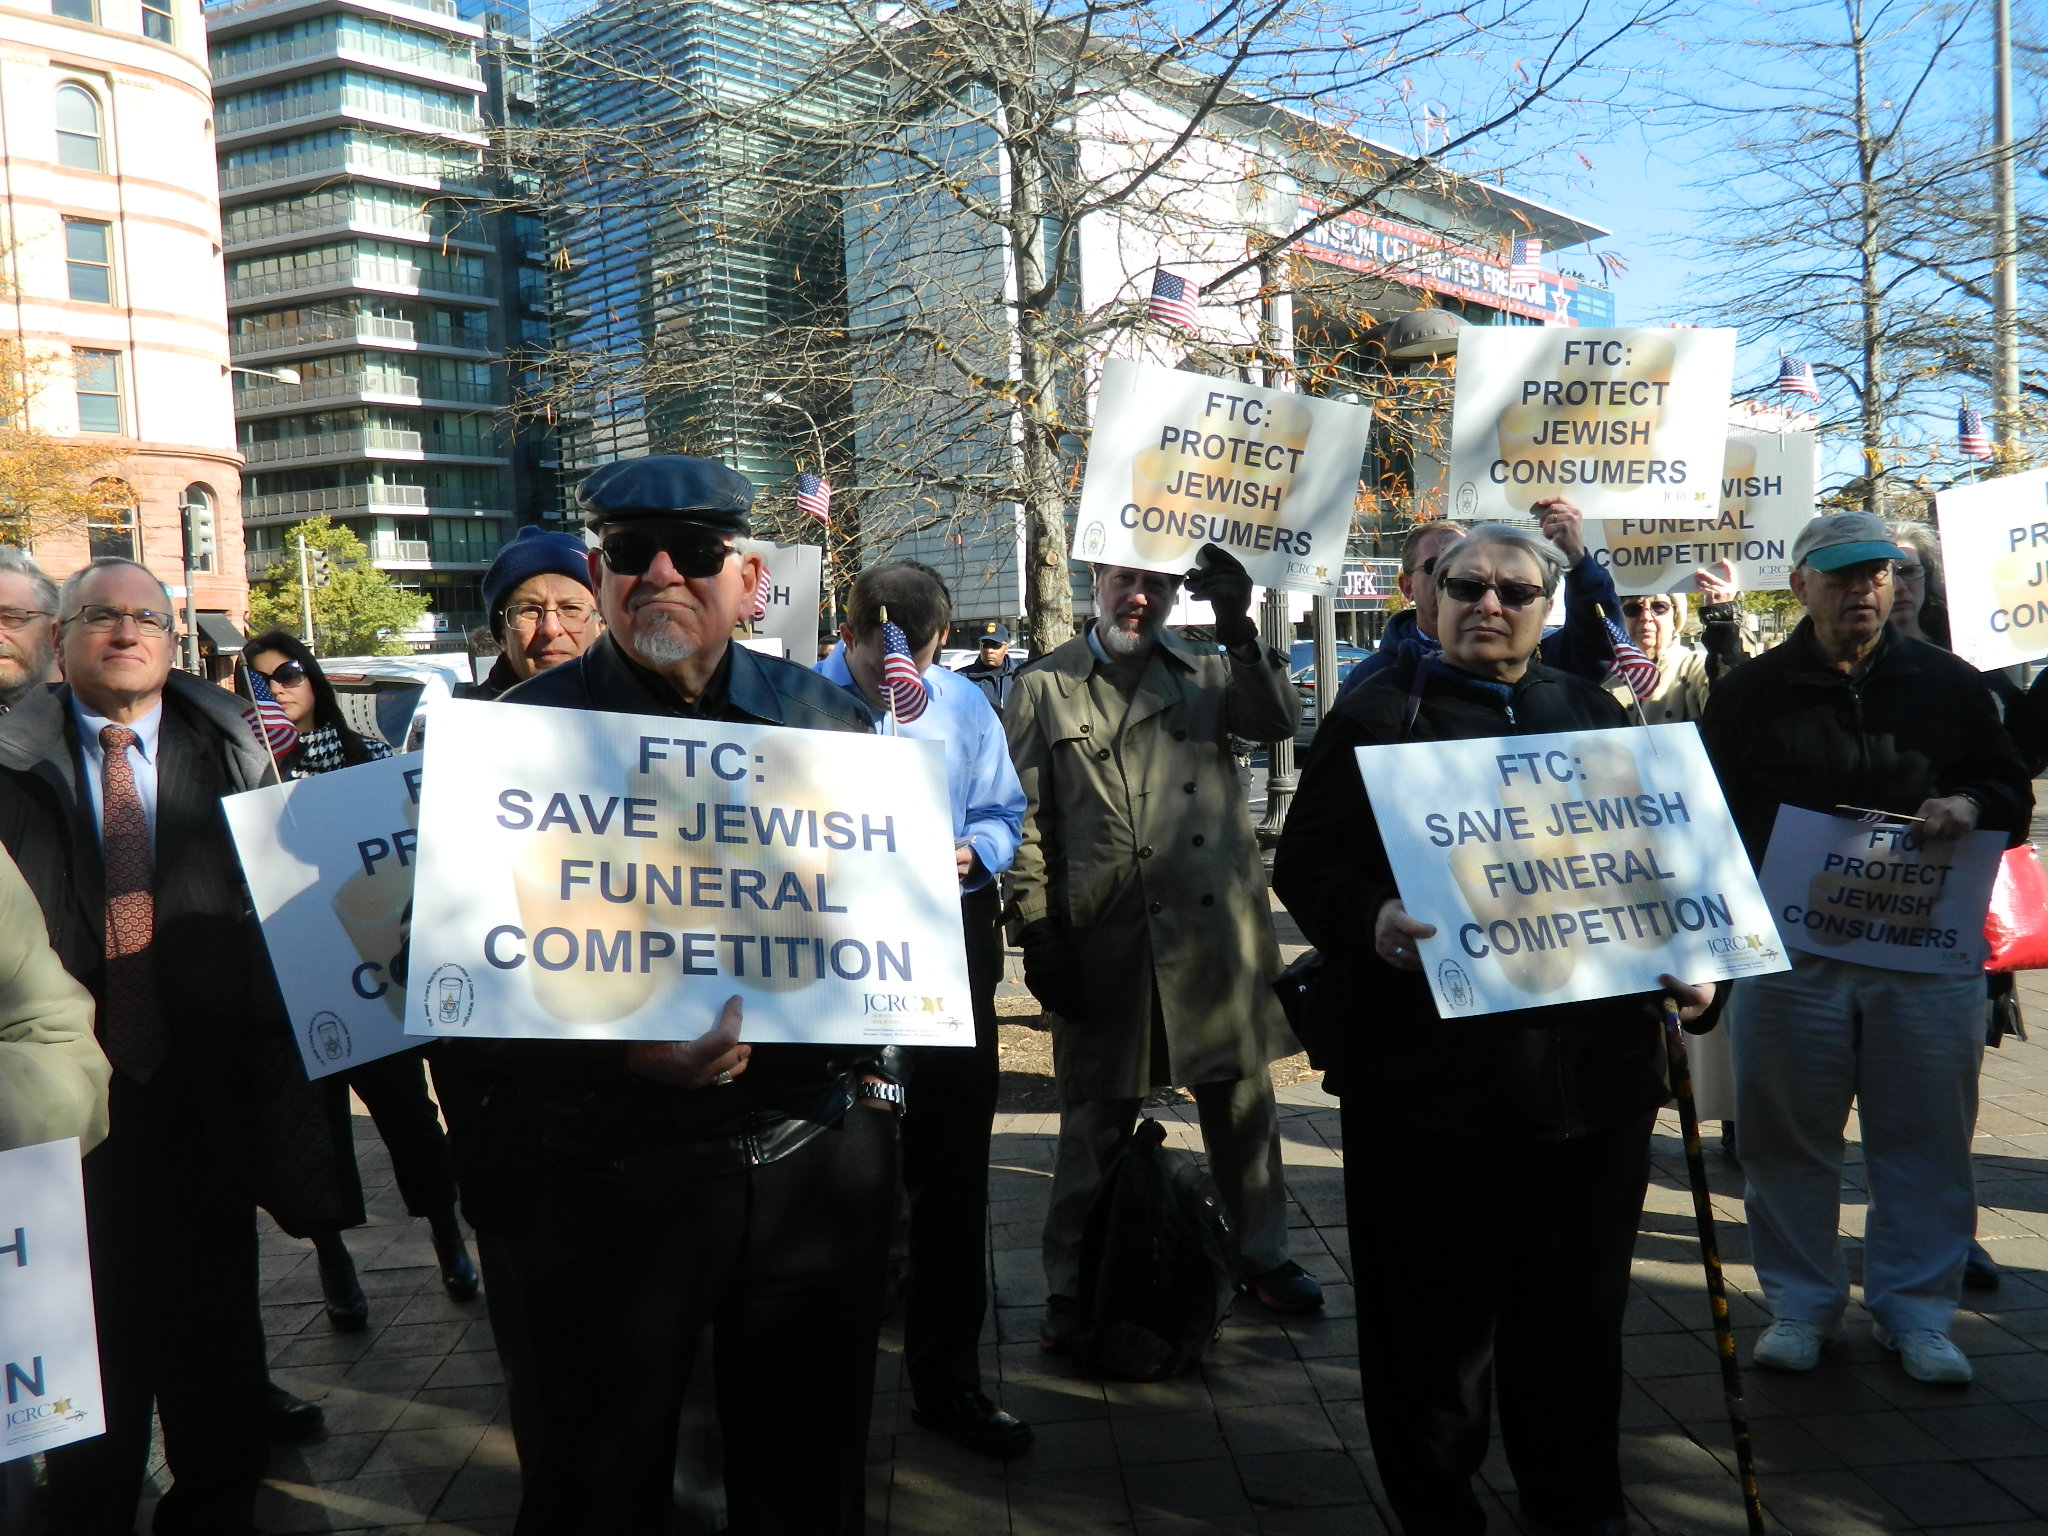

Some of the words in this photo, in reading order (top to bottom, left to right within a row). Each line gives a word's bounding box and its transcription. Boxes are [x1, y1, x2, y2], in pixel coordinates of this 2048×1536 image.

[1483, 265, 1547, 307] FREEDOM
[1563, 340, 1632, 367] FTC:
[1205, 391, 1273, 428] FTC:
[1521, 380, 1670, 406] PROTECT
[1160, 425, 1304, 474] PROTECT
[1532, 420, 1651, 446] JEWISH
[1489, 459, 1688, 485] CONSUMERS
[1166, 470, 1282, 512] JEWISH
[1120, 503, 1313, 557] CONSUMERS
[1622, 509, 1755, 536] FUNERAL
[1286, 561, 1315, 575] JCRC
[1593, 539, 1785, 568] COMPETITION
[1758, 565, 1786, 576] JCRC
[1344, 571, 1377, 595] JFK
[639, 735, 765, 783] FTC:
[1495, 750, 1586, 787] FTC:
[495, 788, 658, 839] SAVE
[678, 801, 897, 853] JEWISH
[1425, 806, 1534, 848] SAVE
[1545, 791, 1691, 837] JEWISH
[559, 858, 848, 914] FUNERAL
[1482, 847, 1675, 899] FUNERAL
[1823, 852, 1953, 887] PROTECT
[1828, 885, 1934, 917] JEWISH
[1459, 892, 1734, 959] COMPETITION
[1782, 904, 1959, 949] CONSUMERS
[483, 923, 913, 983] COMPETITION
[1707, 935, 1746, 958] JCRC
[6, 1403, 51, 1431] JCRC
